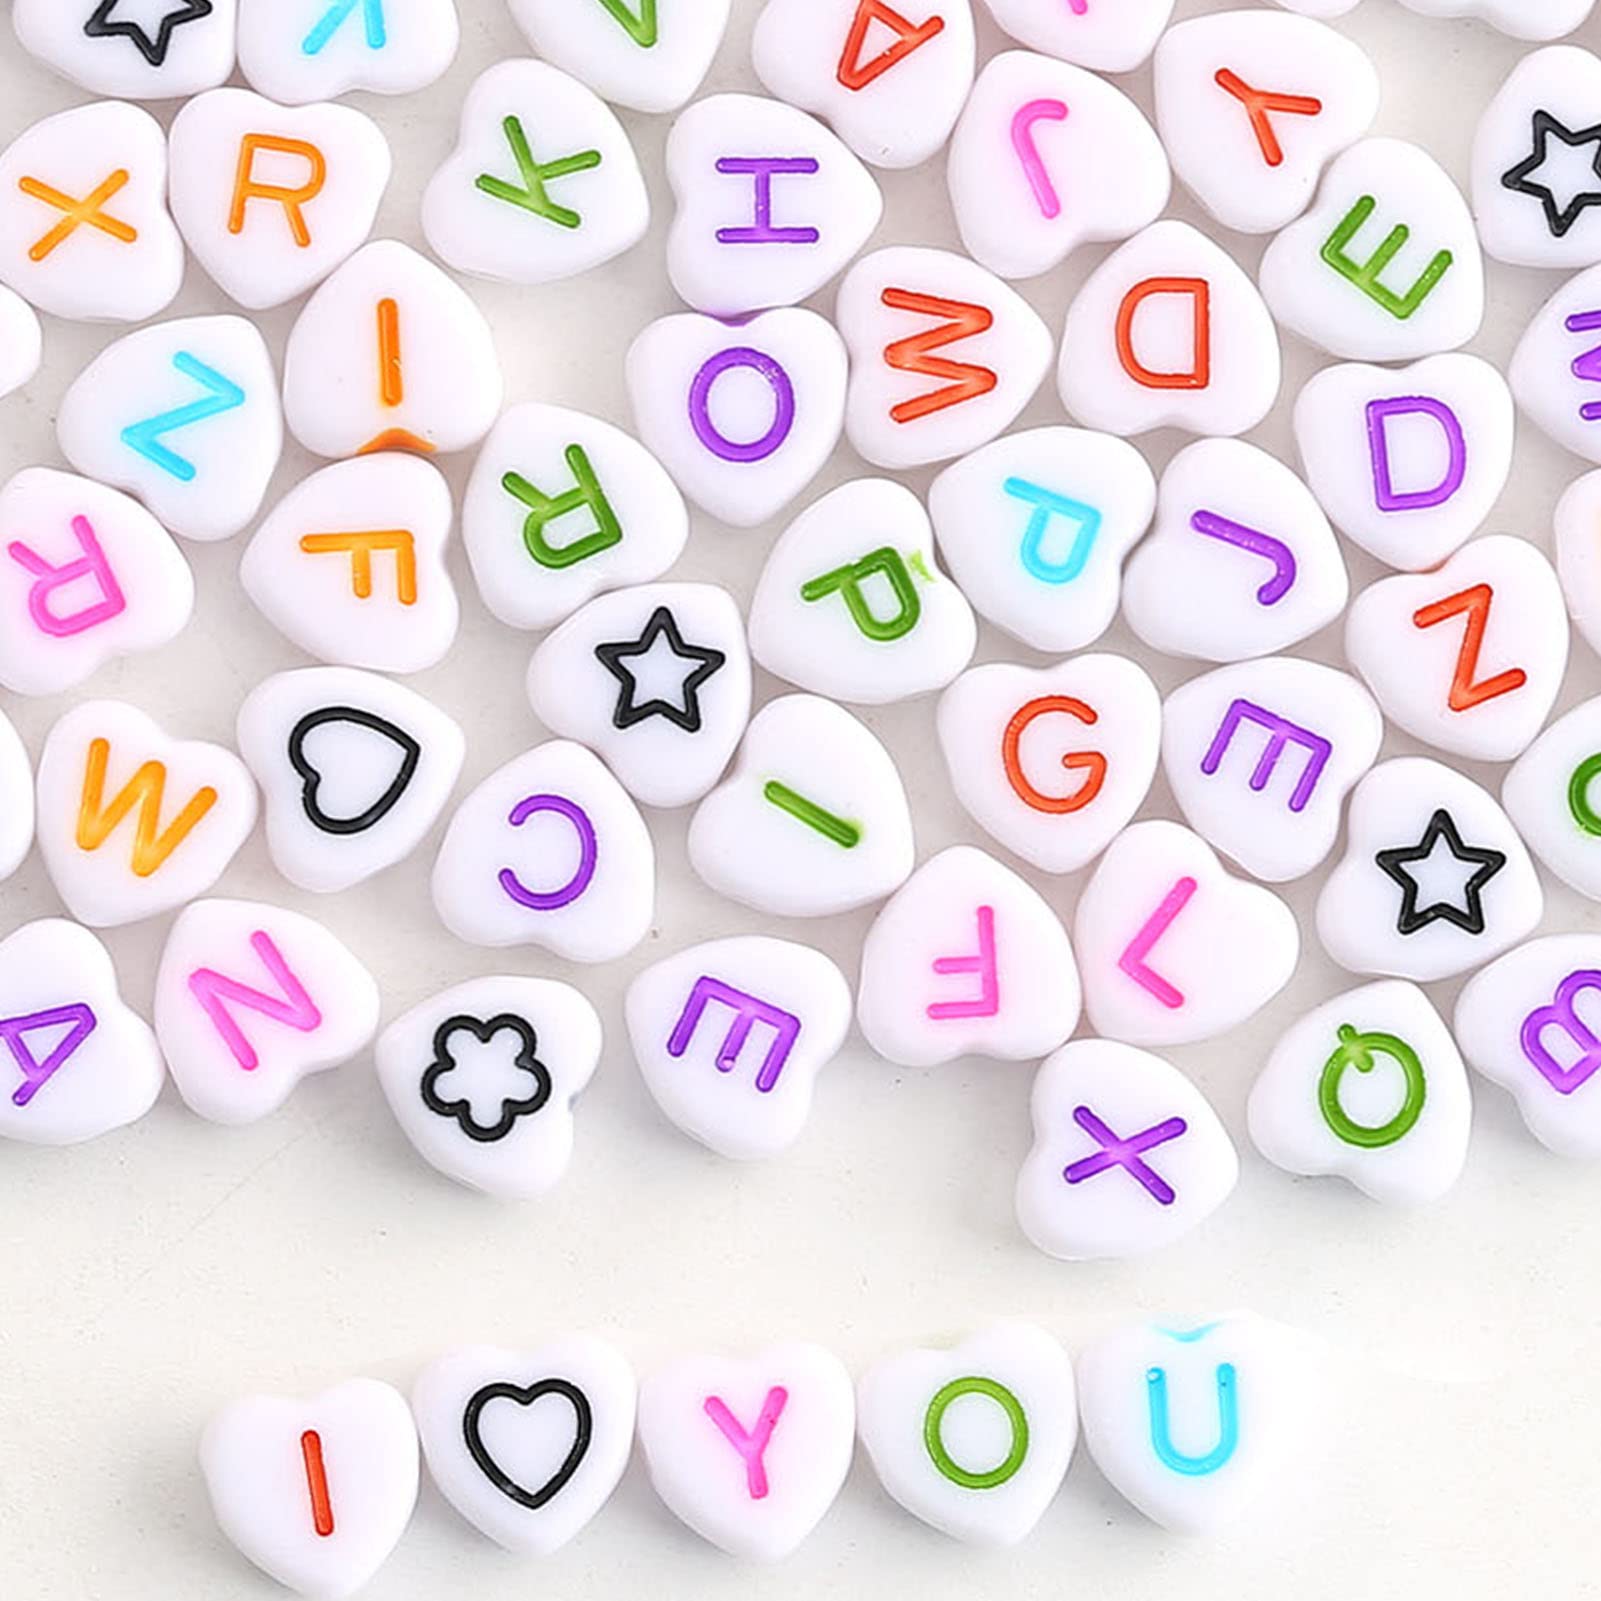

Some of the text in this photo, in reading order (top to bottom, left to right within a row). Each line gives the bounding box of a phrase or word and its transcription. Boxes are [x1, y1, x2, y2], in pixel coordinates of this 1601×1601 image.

[476, 116, 601, 228] K
[1010, 98, 1069, 220] J
[1214, 68, 1322, 167] Y
[18, 168, 138, 262] X
[227, 133, 327, 248] R
[1321, 196, 1452, 320] E
[376, 298, 404, 410] I
[1115, 277, 1210, 390] D
[120, 351, 245, 482] Z
[688, 347, 795, 463] O
[1365, 396, 1466, 512] D
[503, 444, 622, 569] R
[1003, 477, 1102, 585] P
[1190, 510, 1296, 606] J
[7, 514, 127, 638] R
[299, 529, 418, 606] F
[801, 547, 920, 642] P
[1413, 583, 1527, 712] Z
[75, 738, 218, 878] W
[1001, 695, 1108, 815] G
[1200, 699, 1332, 812] E
[499, 794, 598, 911] C
[764, 781, 859, 848] I
[926, 905, 1000, 1020] F
[1117, 876, 1198, 1009] L
[0, 1003, 97, 1106] A
[188, 930, 322, 1071] N
[666, 976, 801, 1093] E
[1520, 970, 1601, 1095] B
[1319, 1024, 1426, 1149] Q
[1063, 1105, 1187, 1205] X
[301, 1430, 334, 1537] I
